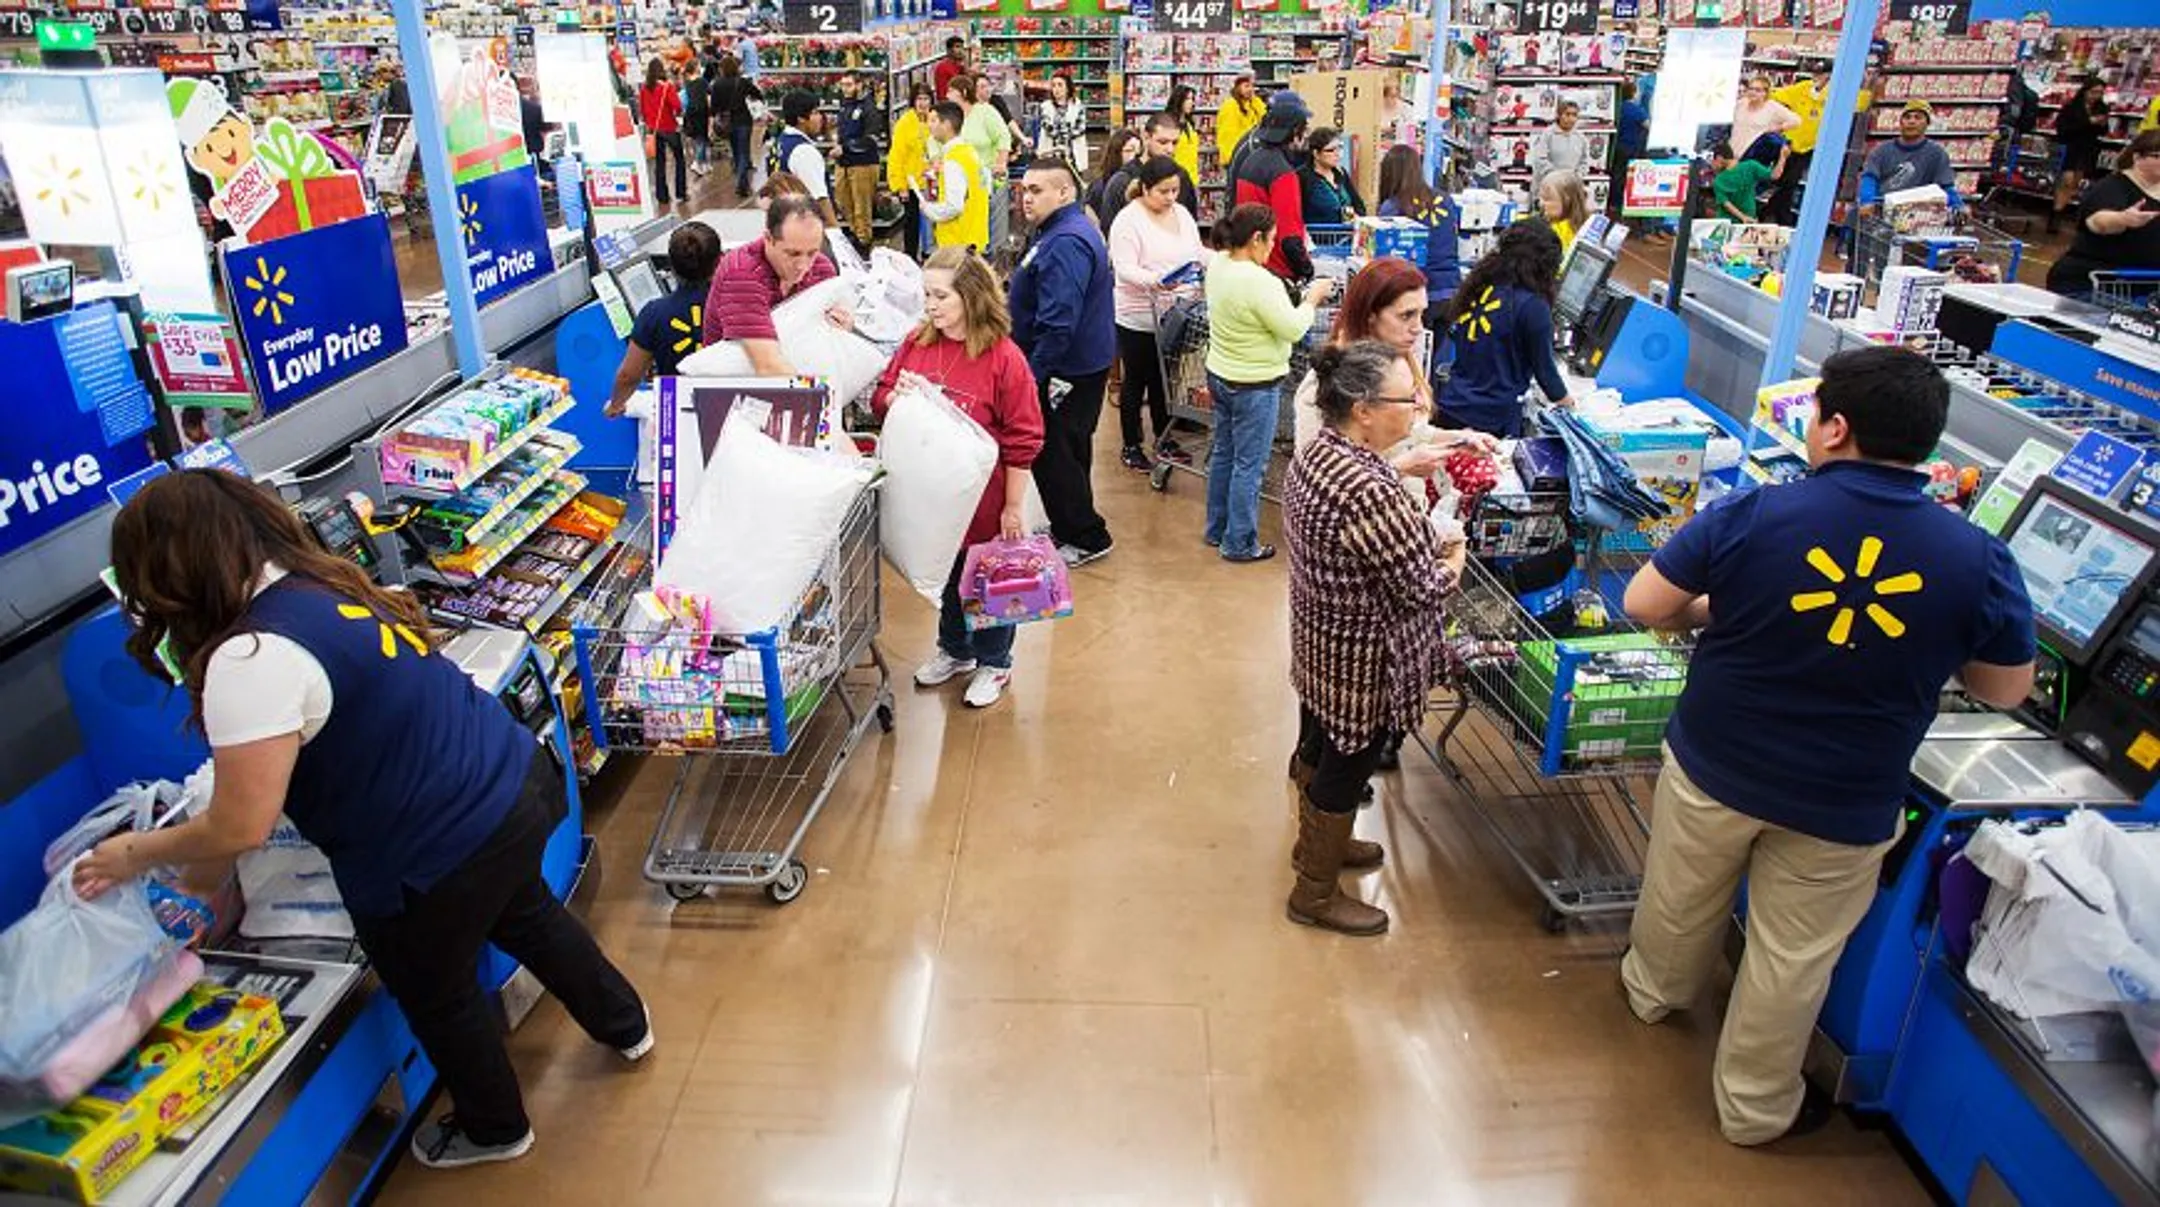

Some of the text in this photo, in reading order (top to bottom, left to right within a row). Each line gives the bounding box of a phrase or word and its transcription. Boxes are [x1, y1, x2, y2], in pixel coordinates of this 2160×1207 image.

[810, 5, 838, 31] $2
[221, 160, 262, 214] MERRY
[497, 249, 535, 282] Price
[262, 327, 315, 356] Everyday
[267, 322, 382, 393] Low Price
[0, 453, 103, 530] Price
